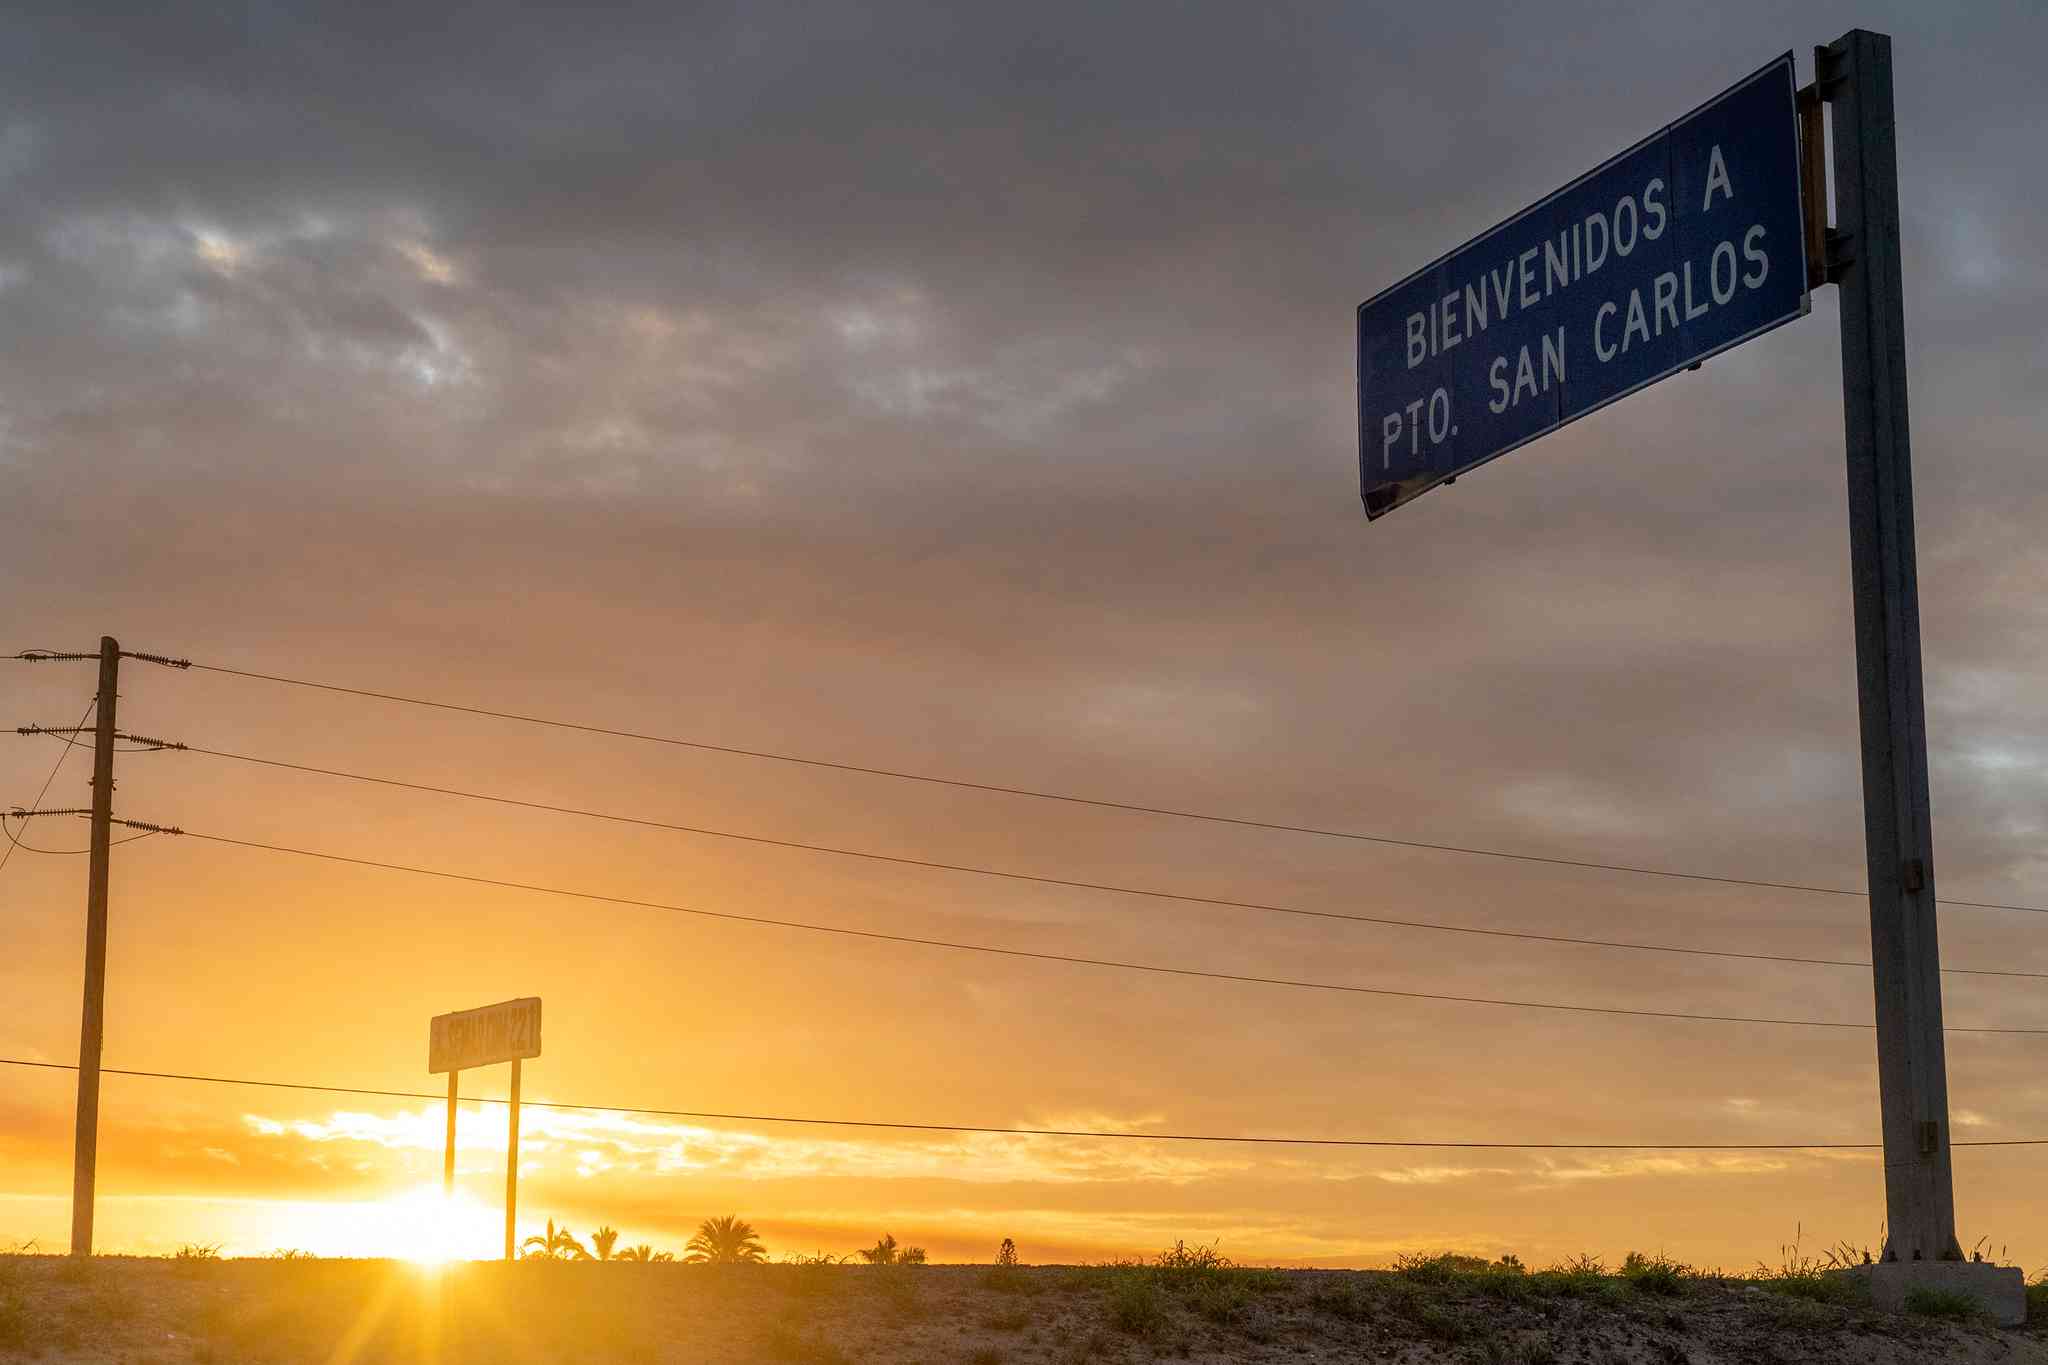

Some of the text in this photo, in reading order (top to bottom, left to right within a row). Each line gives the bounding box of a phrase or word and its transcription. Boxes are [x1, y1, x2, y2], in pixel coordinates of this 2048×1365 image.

[1383, 224, 1769, 469] PTO. SAN CARLOS
[1407, 144, 1734, 369] BIENVENIDOS A
